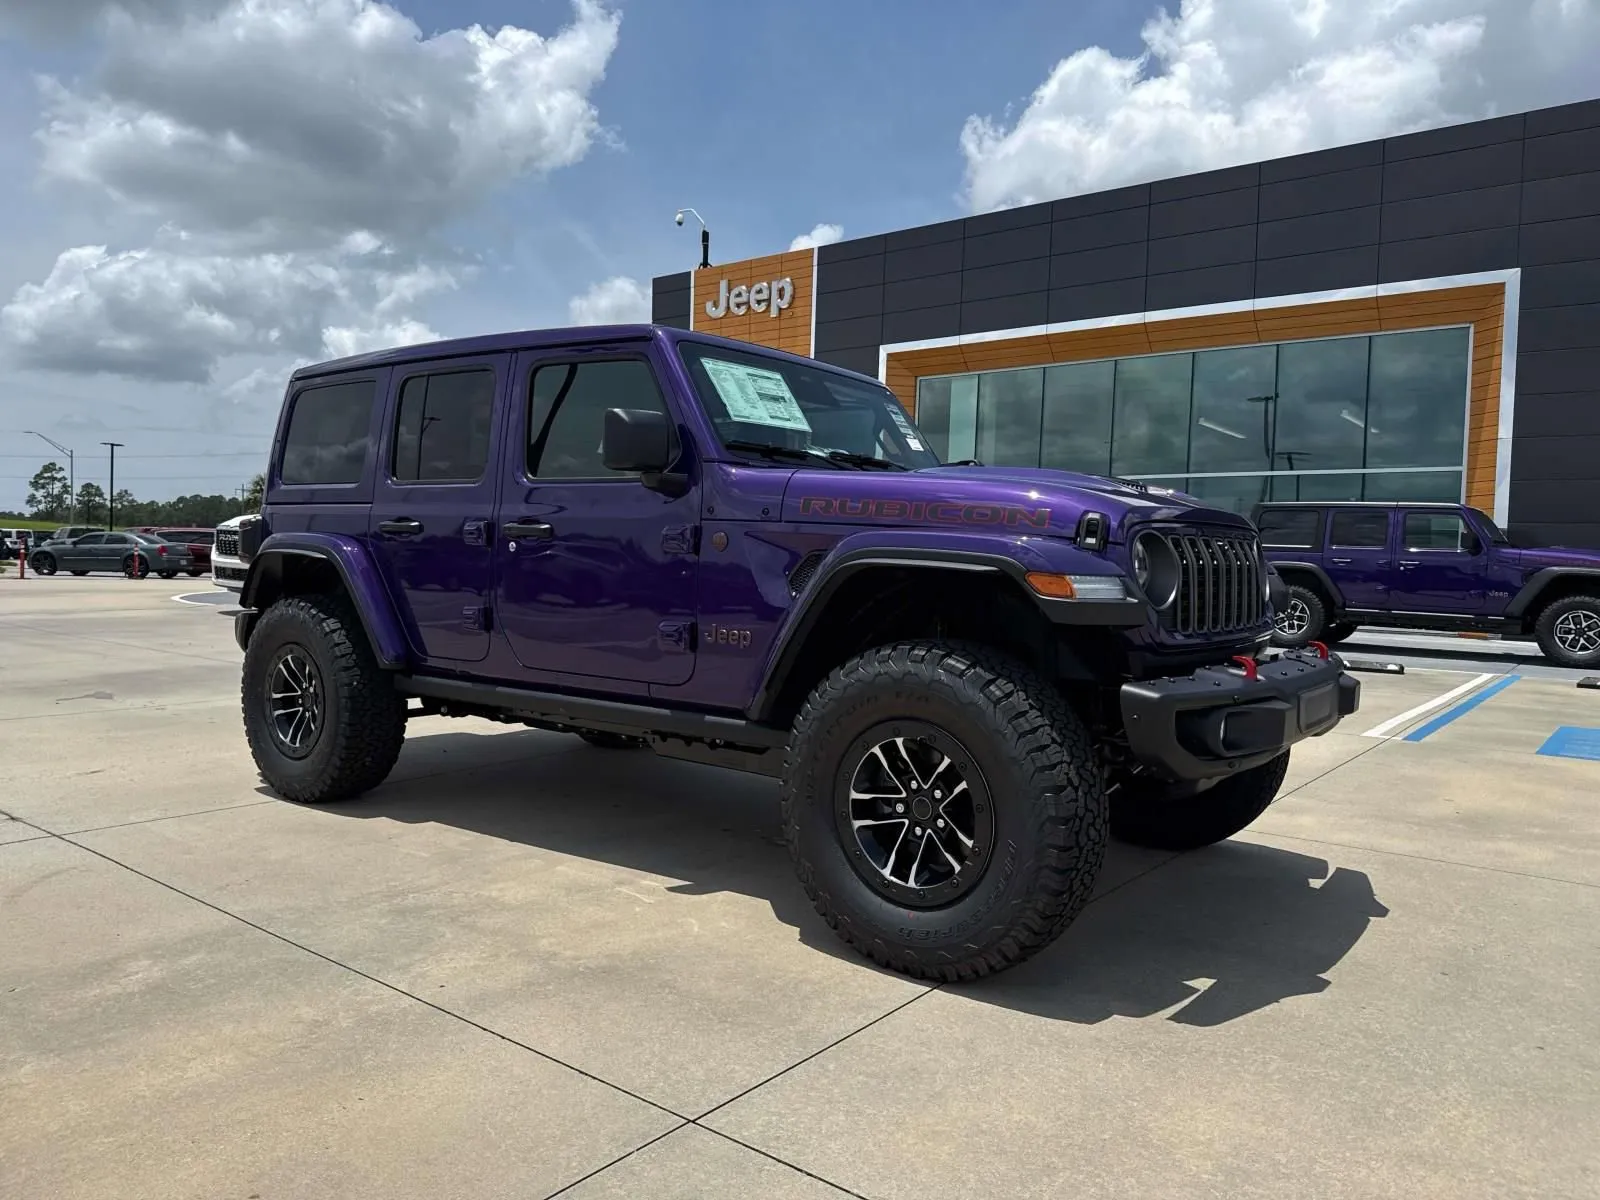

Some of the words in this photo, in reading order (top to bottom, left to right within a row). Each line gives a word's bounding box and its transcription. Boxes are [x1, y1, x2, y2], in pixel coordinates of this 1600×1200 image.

[705, 277, 793, 319] Jeep
[800, 496, 1052, 528] RUBICON
[704, 623, 752, 648] Jeep
